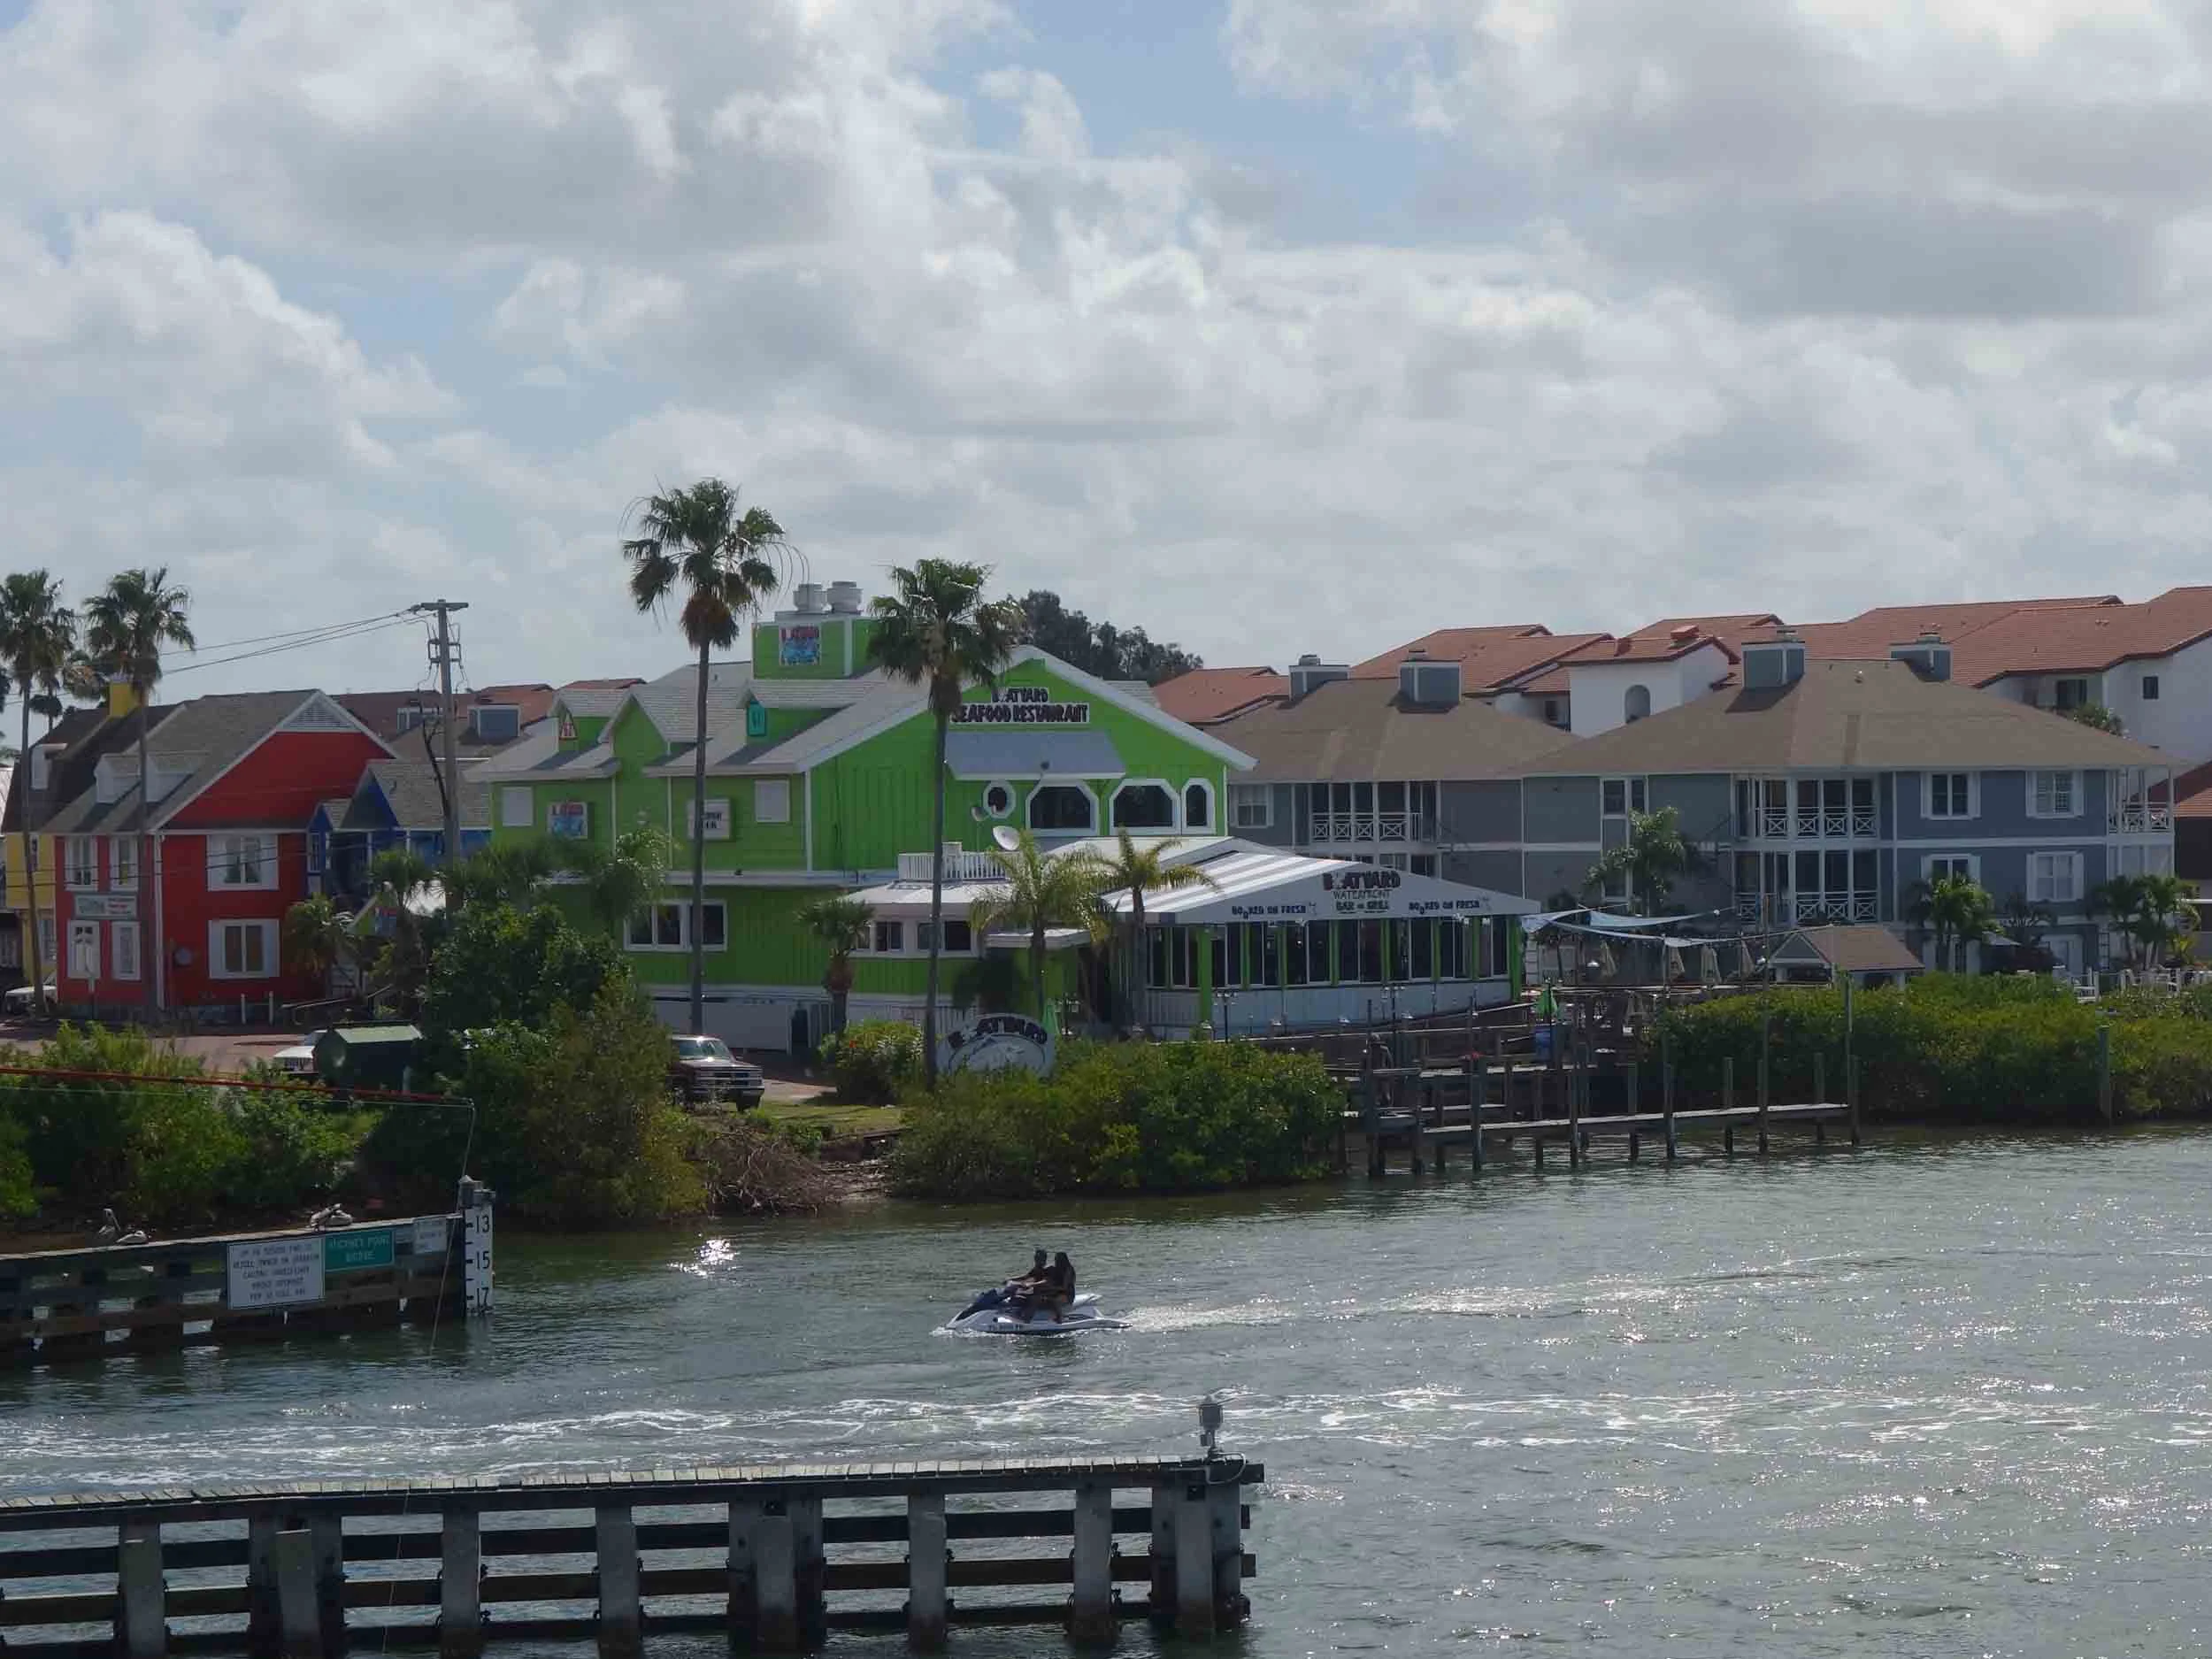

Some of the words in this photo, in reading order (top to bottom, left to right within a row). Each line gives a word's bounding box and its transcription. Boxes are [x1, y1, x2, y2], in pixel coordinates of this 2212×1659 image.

[1013, 704, 1088, 722] RESTAURANT
[476, 1215, 489, 1233] 13
[476, 1251, 490, 1270] 15
[476, 1287, 489, 1307] 17
